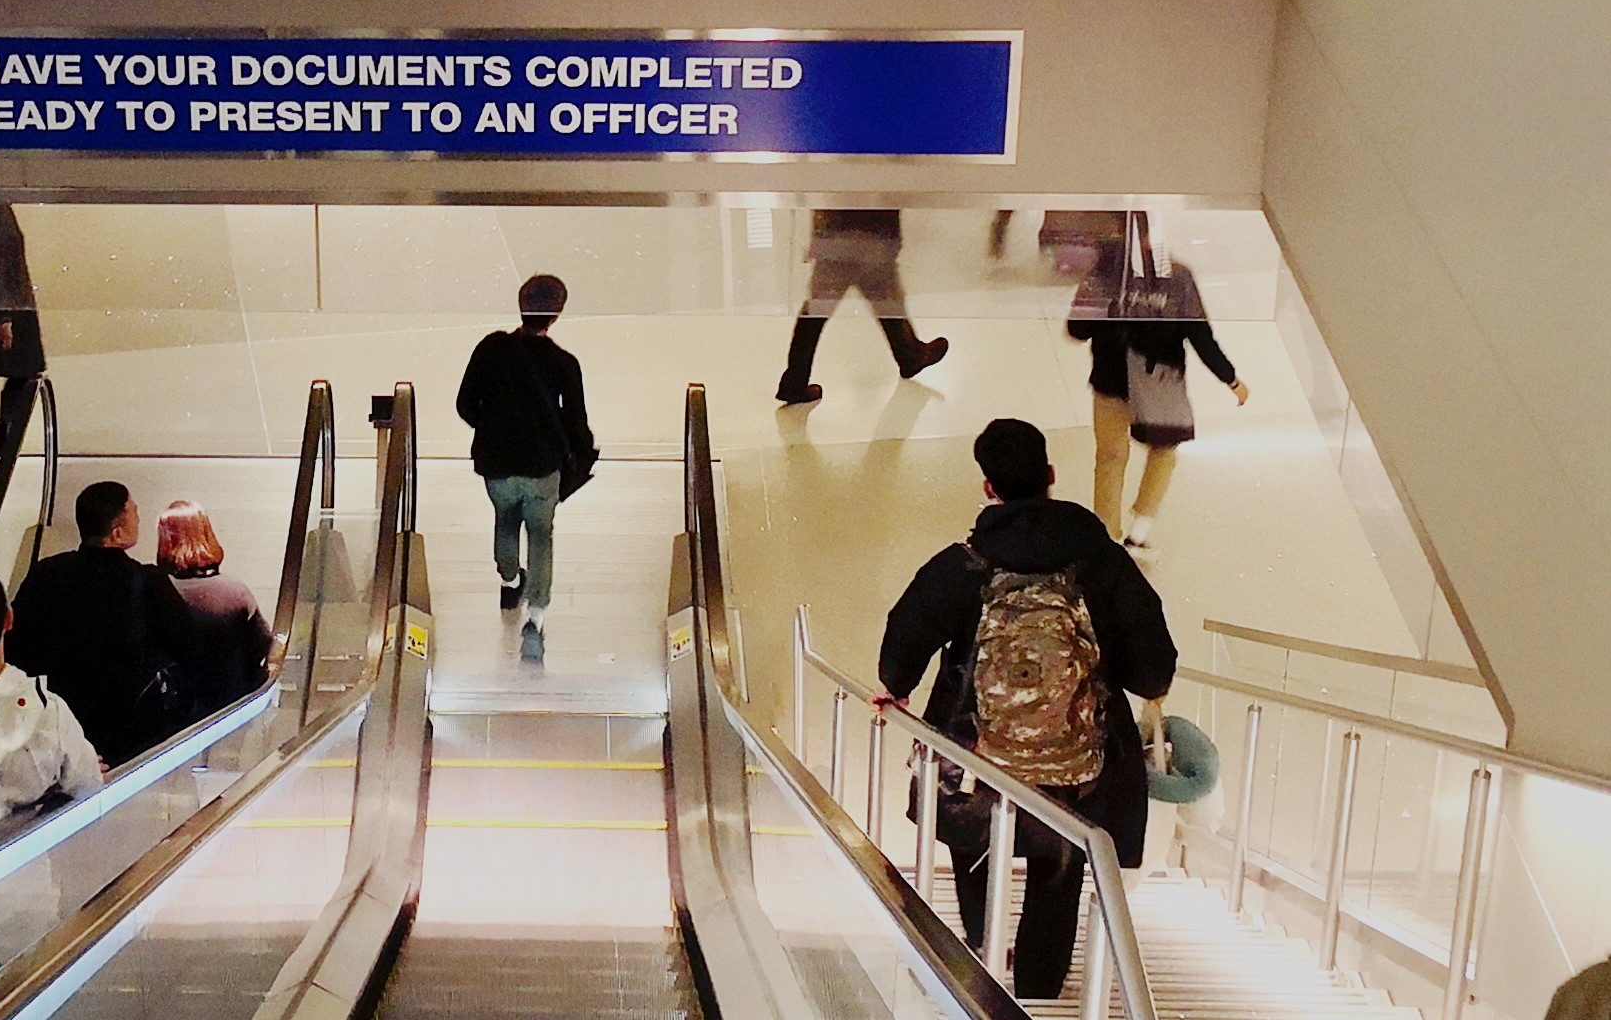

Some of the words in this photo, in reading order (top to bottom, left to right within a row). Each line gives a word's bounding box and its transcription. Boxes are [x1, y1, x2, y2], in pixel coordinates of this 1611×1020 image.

[94, 54, 217, 86] YOUR
[231, 54, 512, 87] DOCUMENTS
[525, 55, 803, 90] COMPLETED
[116, 101, 176, 131] TO
[189, 101, 390, 132] PRESENT
[401, 101, 462, 133] TO
[474, 102, 535, 133] AN
[549, 102, 738, 135] OFFICER
